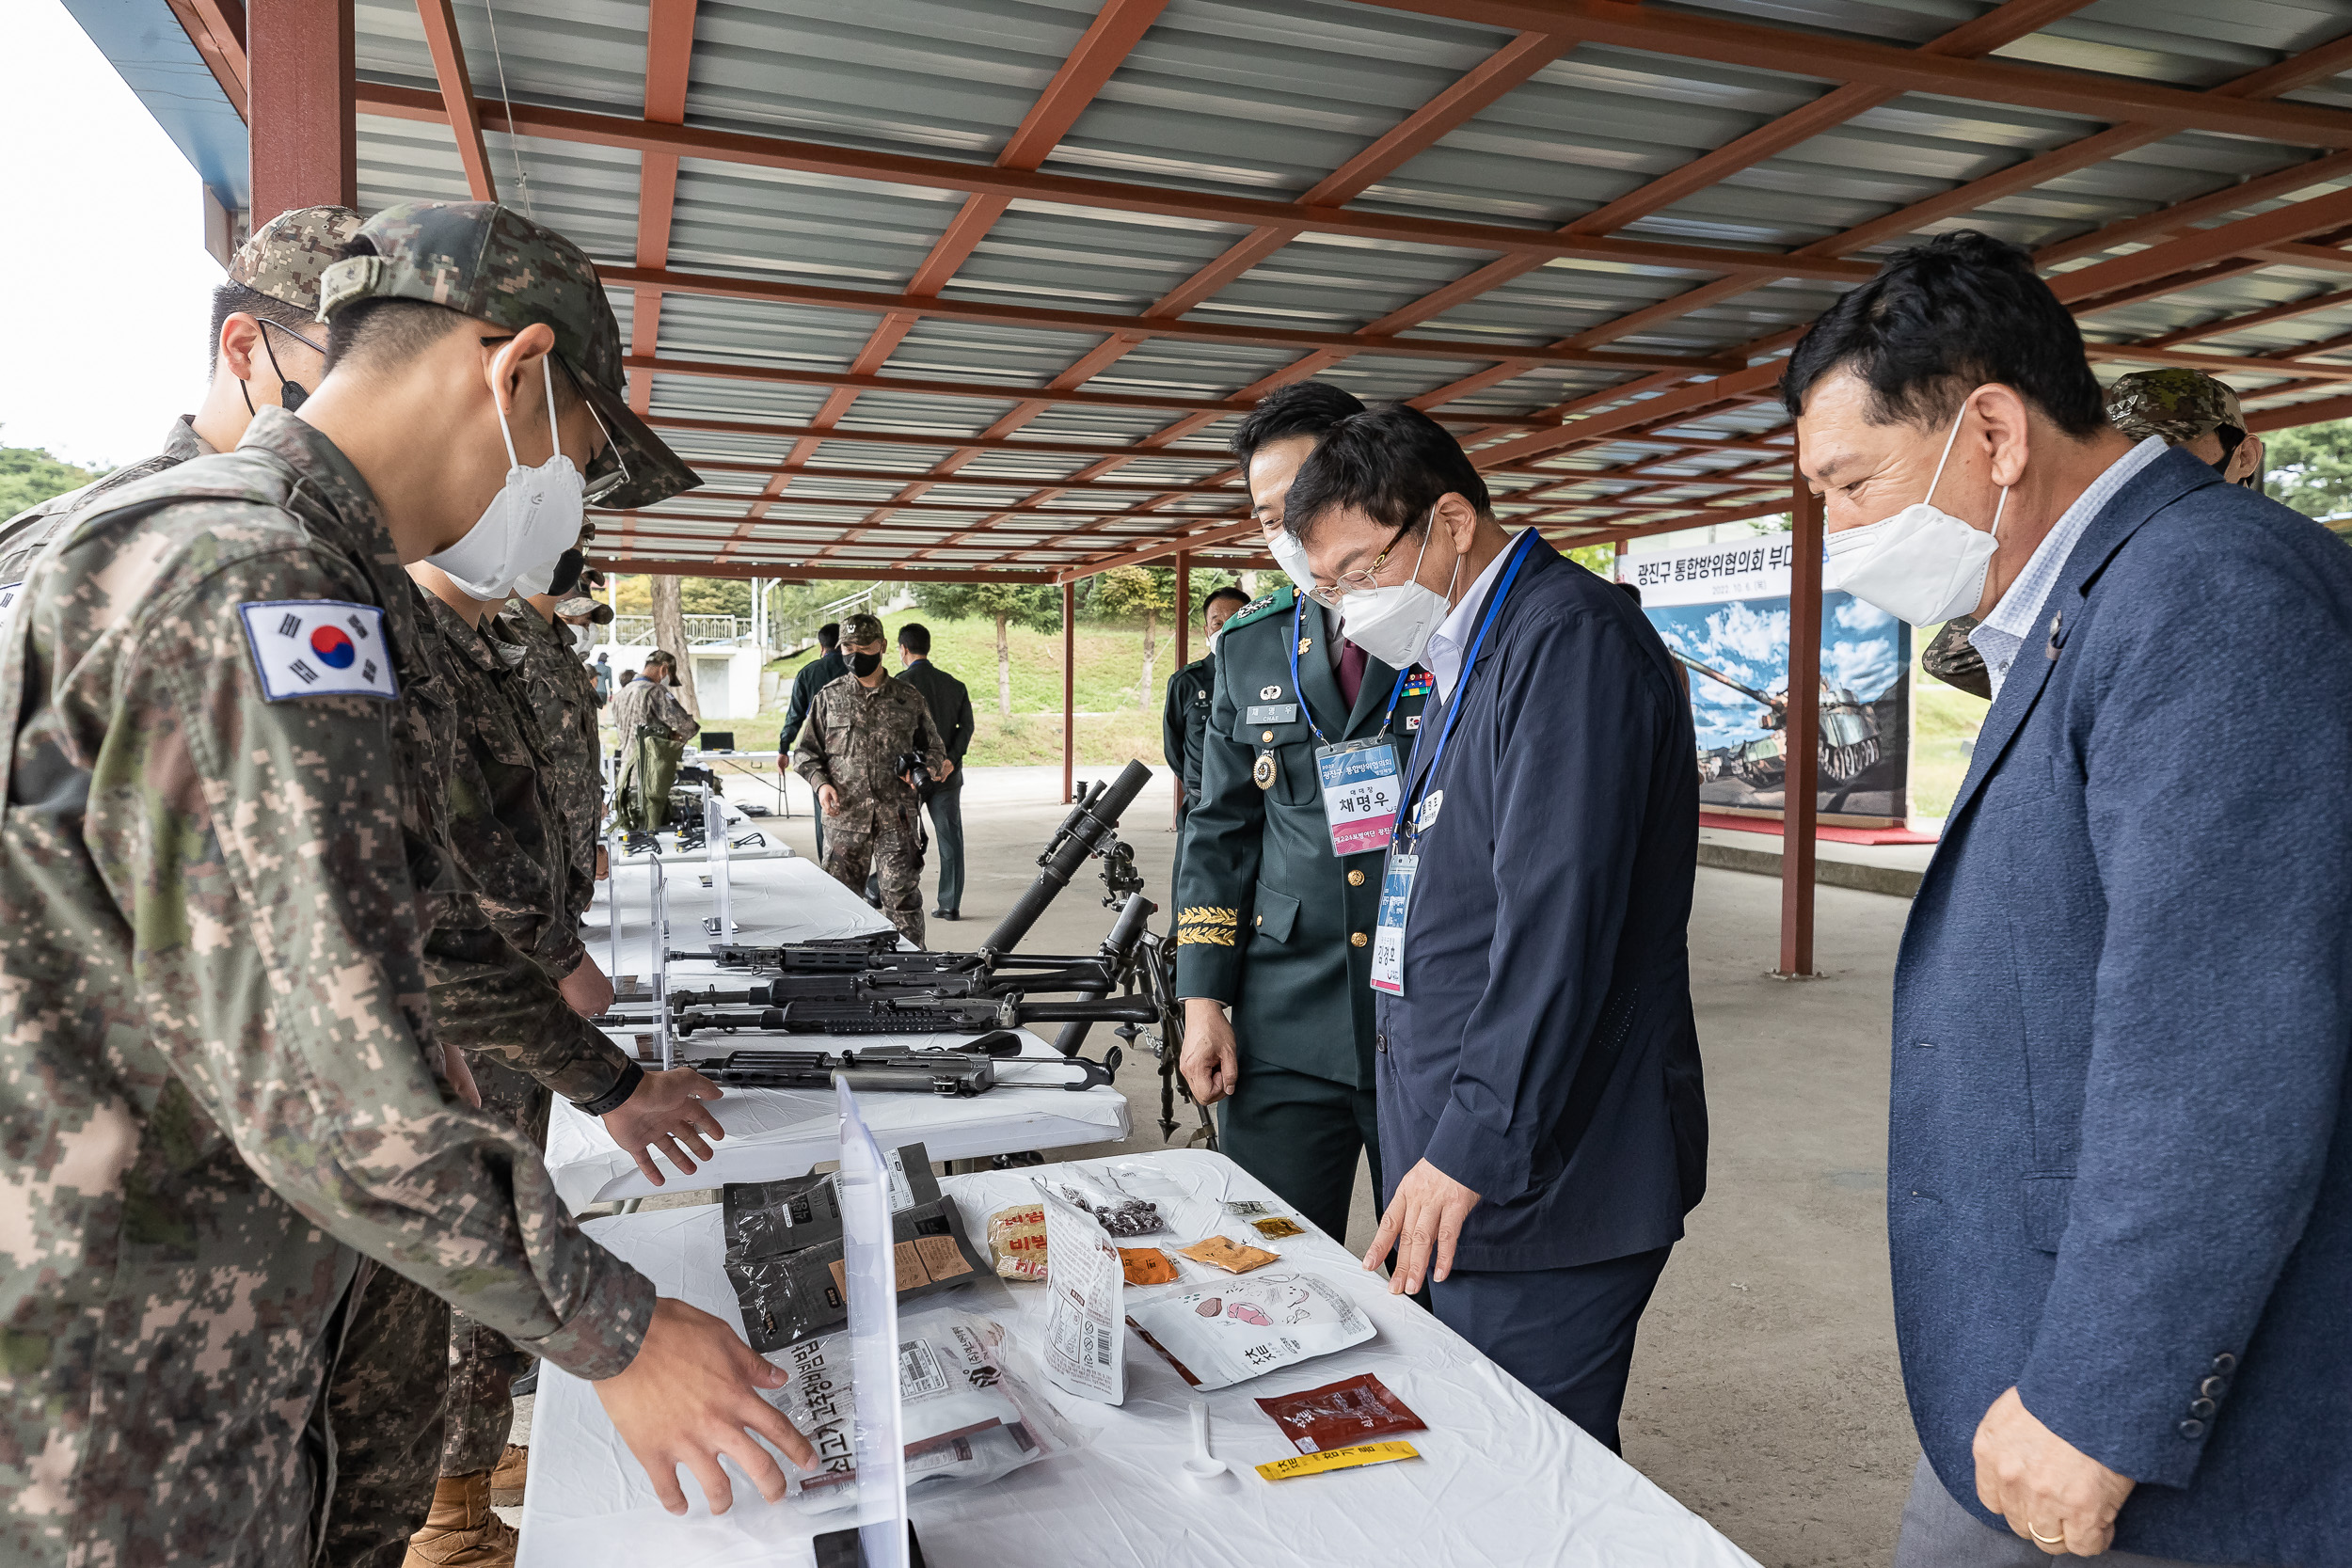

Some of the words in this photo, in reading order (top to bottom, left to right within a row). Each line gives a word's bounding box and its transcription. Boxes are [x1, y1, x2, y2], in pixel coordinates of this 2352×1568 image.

[1638, 561, 1672, 586] 광진구
[1675, 548, 1765, 582] 통합방위협의회
[1323, 768, 1343, 780] 광진구
[1346, 758, 1392, 776] 통합방위협의회
[1339, 792, 1389, 813] 채명우
[791, 1338, 837, 1421] 고추장비빔밥
[818, 1418, 857, 1474] 쇠고기
